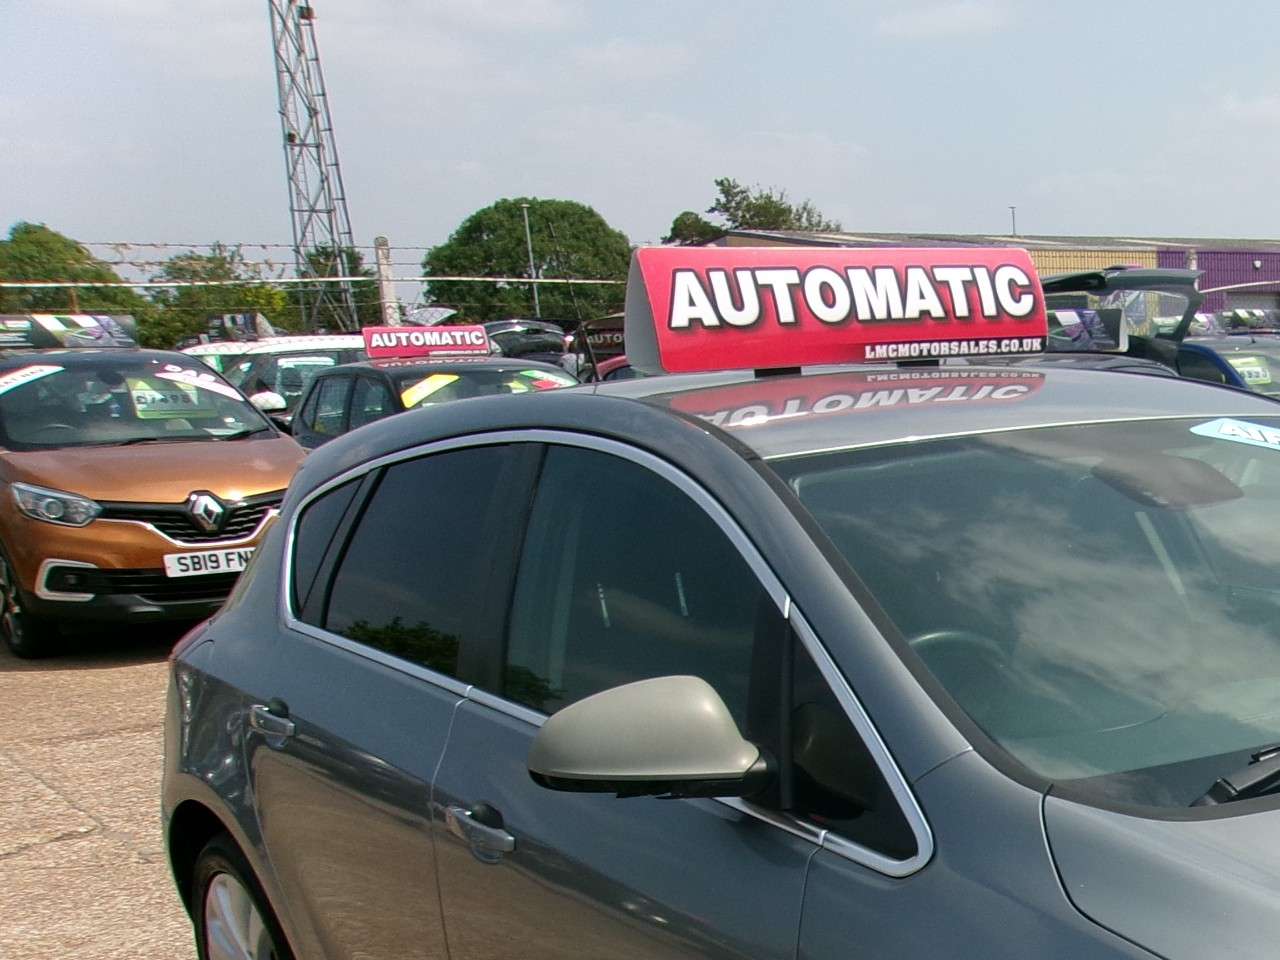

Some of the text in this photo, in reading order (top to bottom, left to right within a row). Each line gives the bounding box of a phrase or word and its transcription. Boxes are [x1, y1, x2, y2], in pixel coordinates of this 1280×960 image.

[668, 263, 1037, 330] AUTOMATIC
[370, 329, 485, 348] AUTOMATIC
[865, 337, 1042, 359] LMCMOTORSALES.CO.UK
[176, 553, 221, 573] SB19
